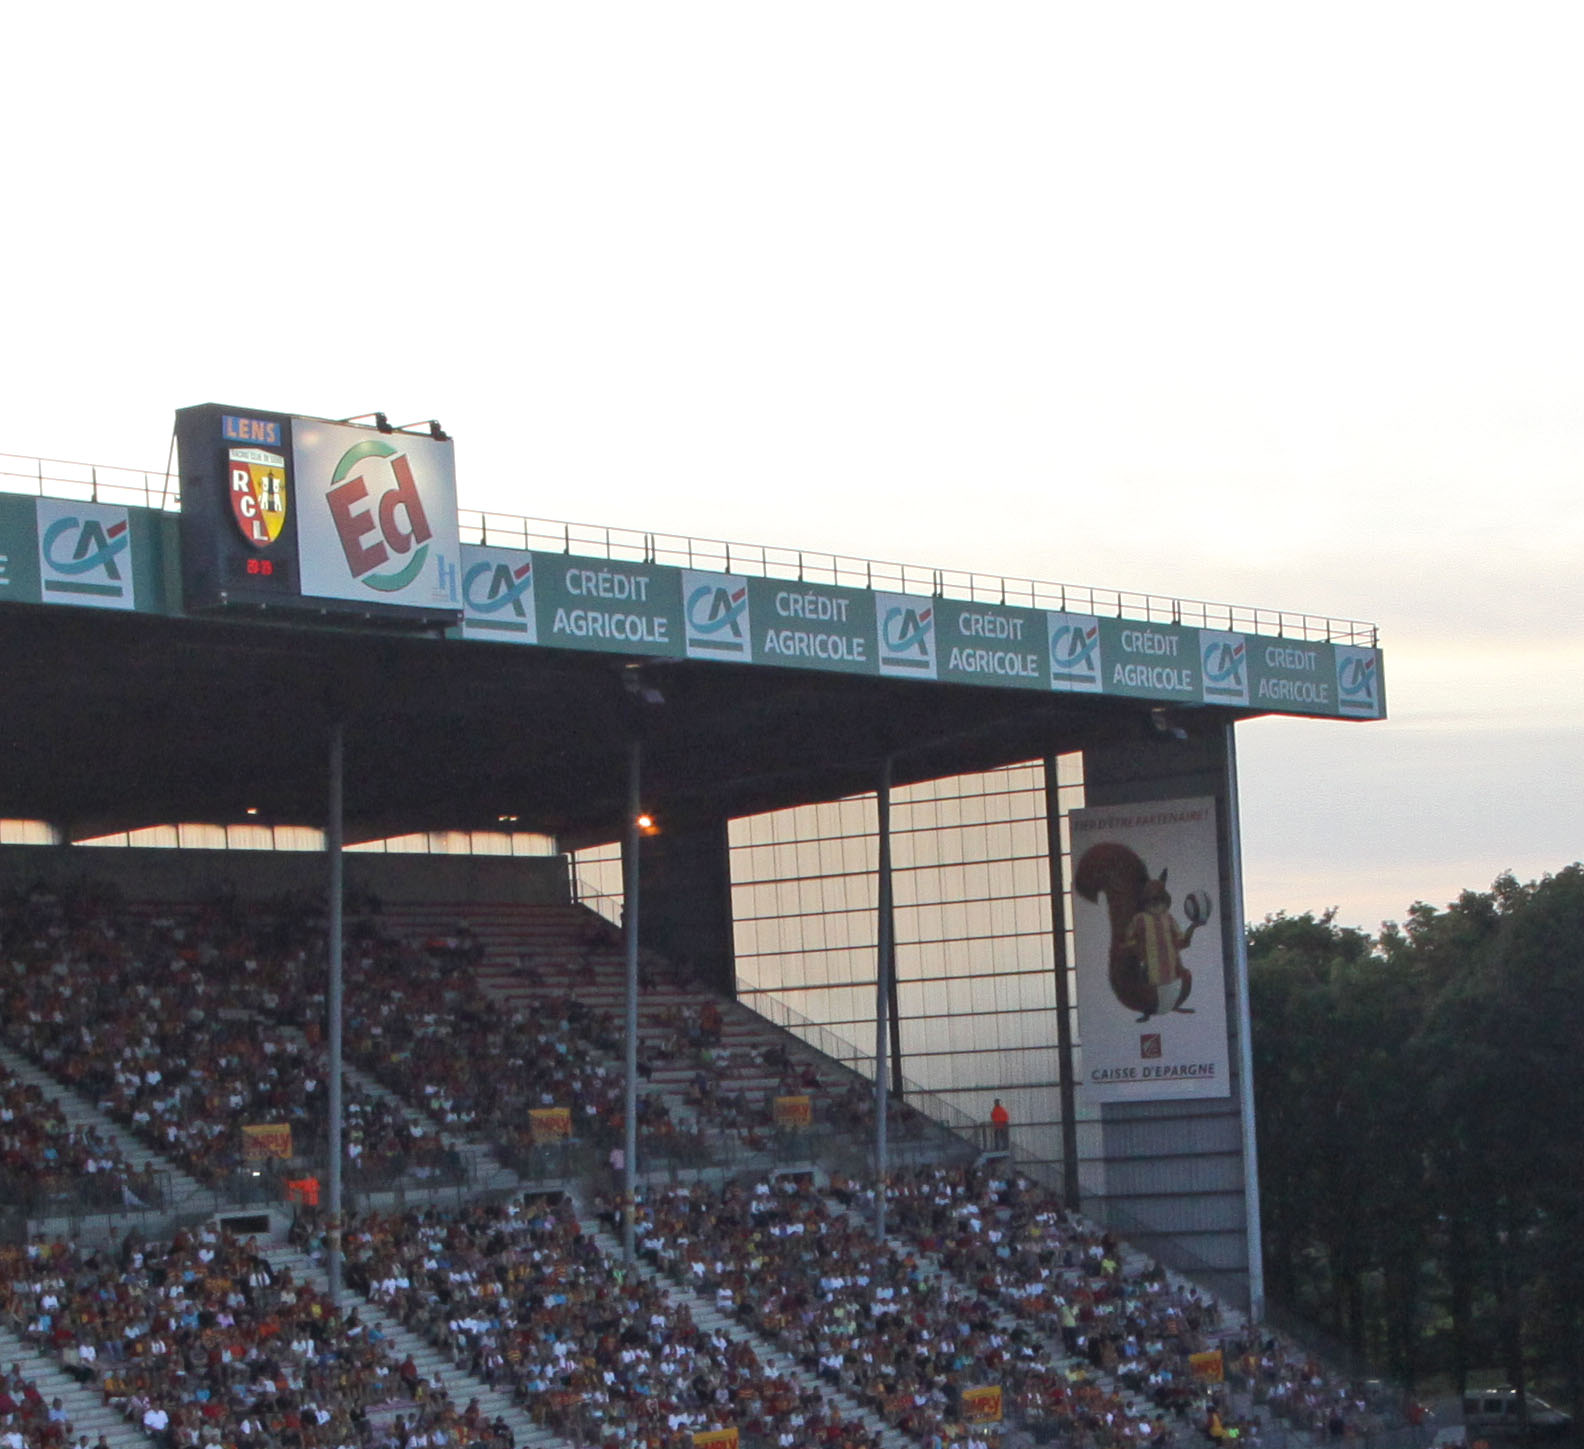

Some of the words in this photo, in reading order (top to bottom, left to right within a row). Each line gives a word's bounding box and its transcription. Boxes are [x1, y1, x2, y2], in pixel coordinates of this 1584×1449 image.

[227, 417, 276, 443] LENS
[325, 453, 432, 580] Ed
[565, 567, 650, 602] CRÉDIT
[775, 590, 850, 624] CRÉDIT
[553, 605, 668, 644] AGRICOLE
[959, 611, 1024, 642] CRÉDIT
[764, 628, 867, 663] AGRICOLE
[1121, 630, 1179, 658] CRÉDIT
[1264, 646, 1317, 671] CRÉDIT
[948, 646, 1039, 678] AGRICOLE
[1113, 662, 1193, 691] AGRICOLE
[1258, 676, 1329, 705] AGRICOLE
[1091, 1066, 1137, 1081] CAISSE
